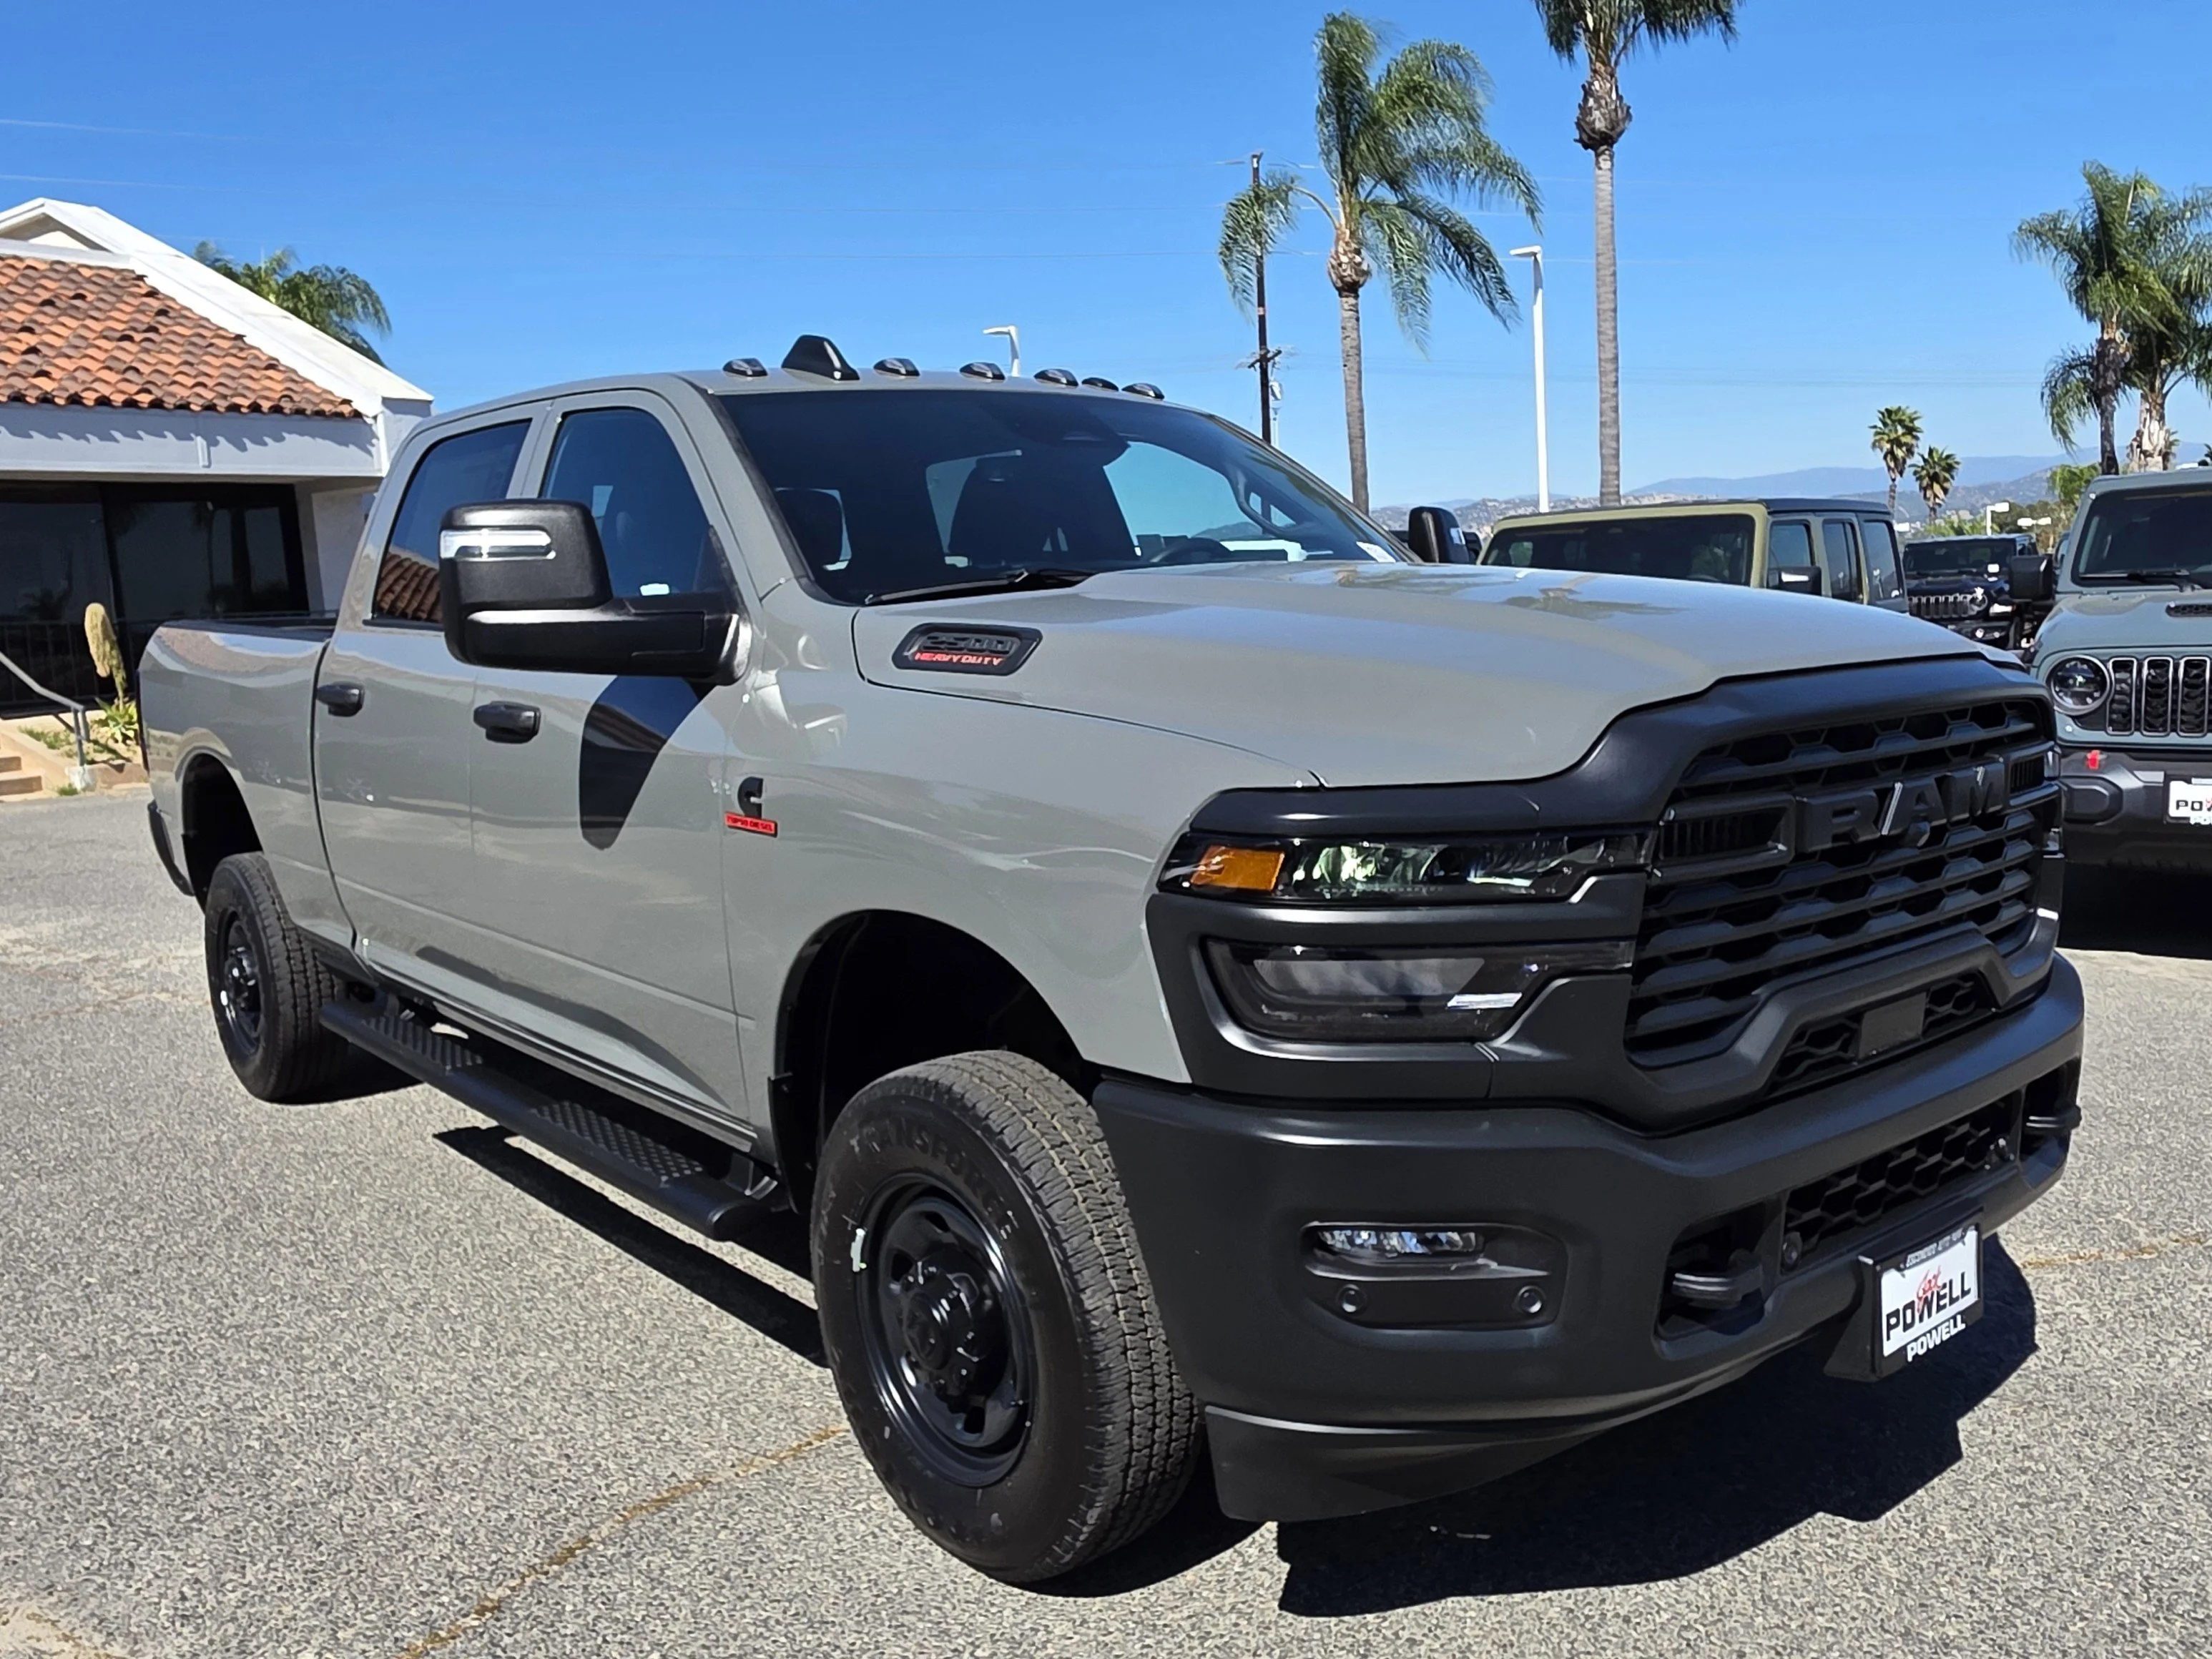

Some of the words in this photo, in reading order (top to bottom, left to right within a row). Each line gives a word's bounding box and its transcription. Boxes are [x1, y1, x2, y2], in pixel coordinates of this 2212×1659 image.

[914, 652, 959, 664] HEAVY
[960, 655, 1005, 666] DUTY
[922, 634, 1015, 654] 2500
[1796, 762, 2004, 852] RAM
[1886, 1271, 1972, 1342] POWELL
[1907, 1314, 1967, 1363] POWELL
